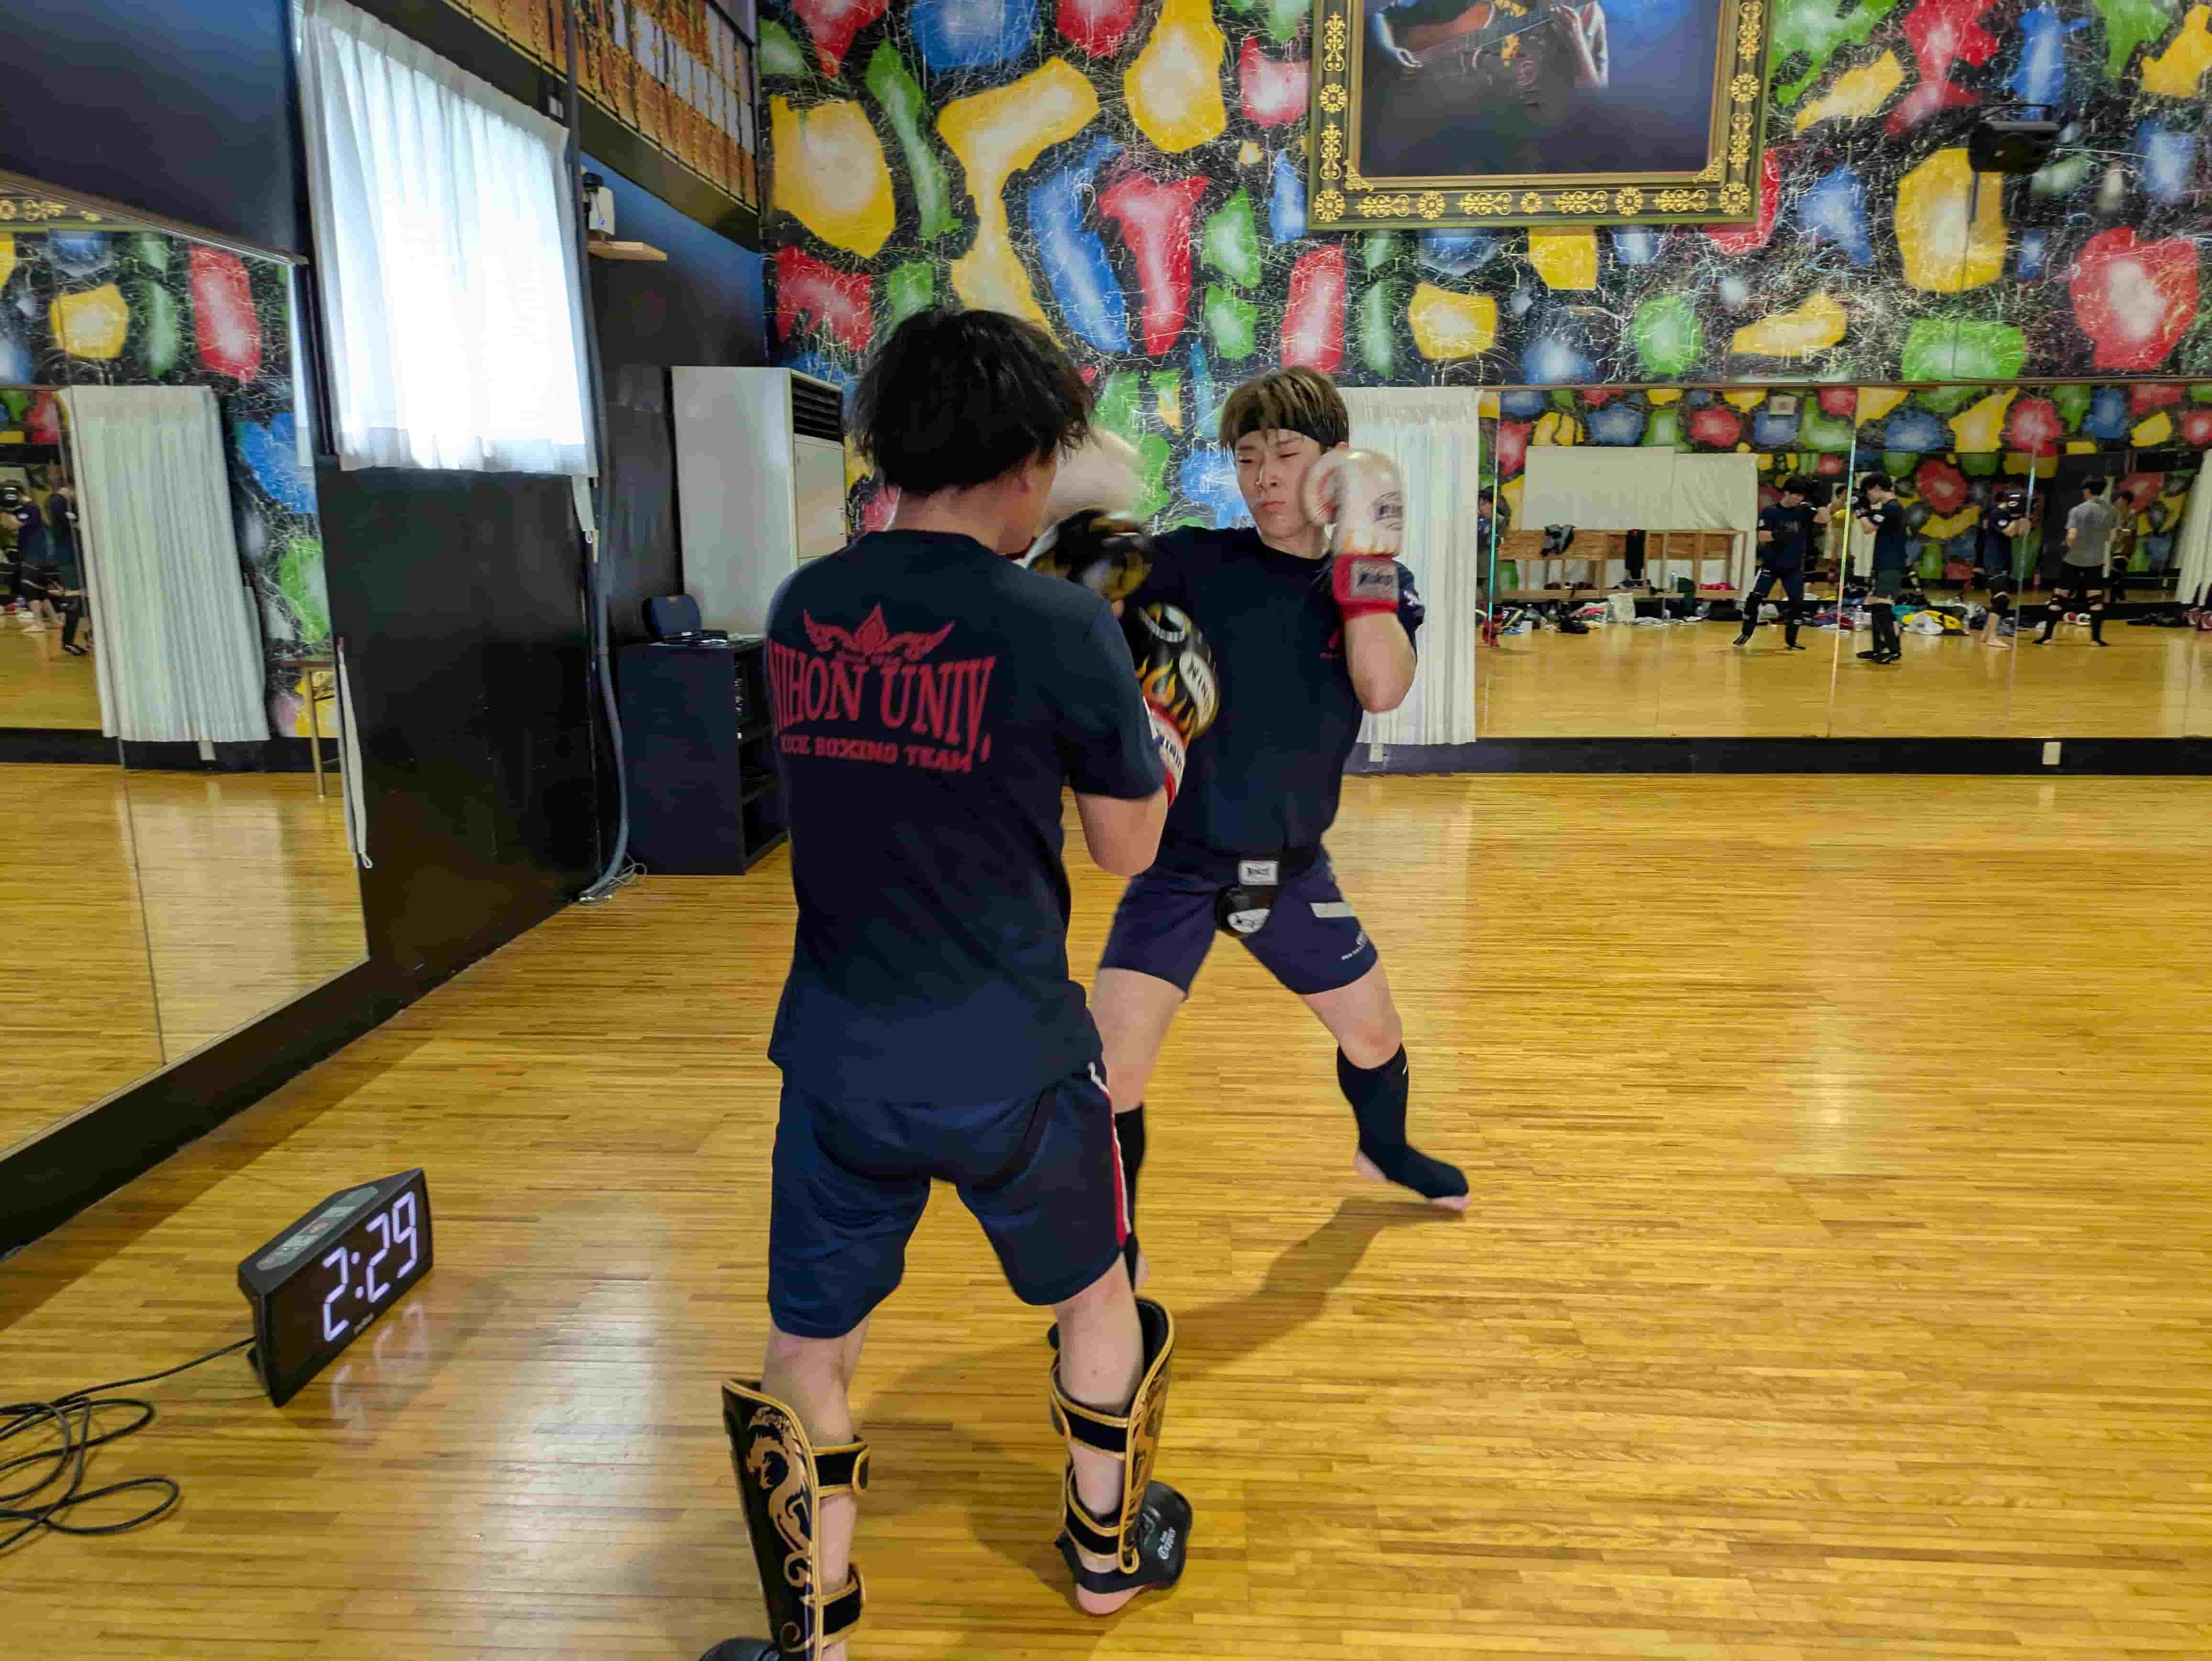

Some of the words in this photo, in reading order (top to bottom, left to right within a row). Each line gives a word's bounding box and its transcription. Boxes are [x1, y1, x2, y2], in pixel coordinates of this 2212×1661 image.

[767, 640, 869, 737] NIHON
[815, 737, 898, 763] BOXING
[905, 746, 972, 772] TEAM
[322, 1191, 418, 1341] 2:29
